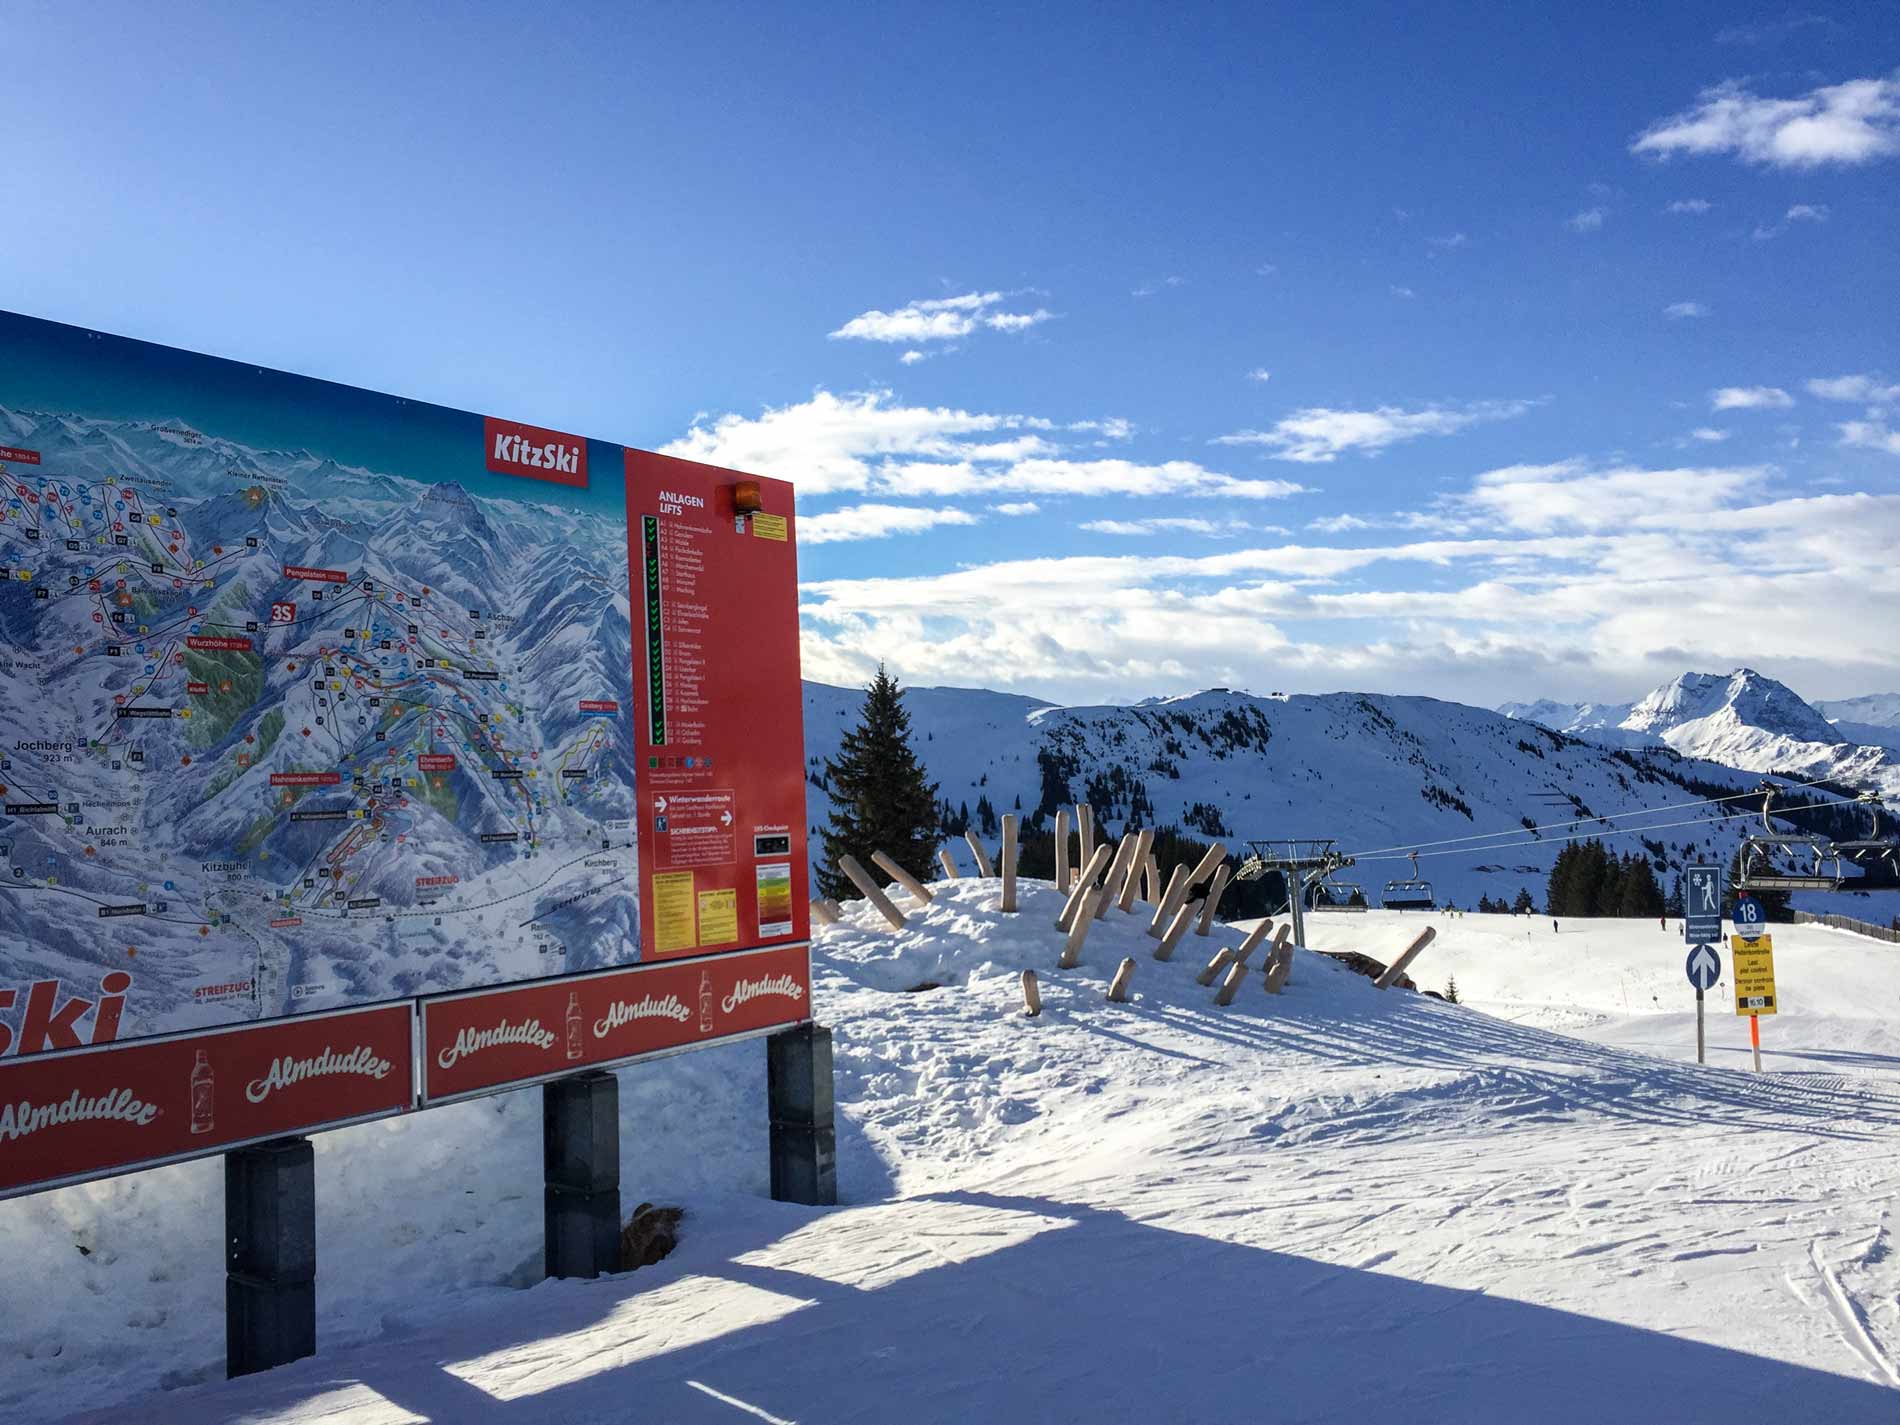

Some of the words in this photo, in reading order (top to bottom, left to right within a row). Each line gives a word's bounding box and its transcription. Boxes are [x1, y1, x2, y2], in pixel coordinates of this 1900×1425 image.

[494, 433, 579, 474] KitzSki
[659, 490, 704, 508] ANLAGEN
[660, 502, 683, 516] LIFTS
[272, 604, 291, 621] 3S
[15, 661, 41, 669] Wacht
[14, 740, 72, 753] Jochberg
[43, 754, 61, 763] 923
[86, 824, 128, 836] Aurach
[1739, 903, 1757, 923] 18
[195, 981, 250, 998] STREIFZUG
[722, 974, 804, 1014] Almdudler
[593, 994, 690, 1038] Almdudler
[438, 1019, 556, 1069] Almdudler
[246, 1046, 392, 1104] Almdudler
[0, 1088, 158, 1142] Almdudler
